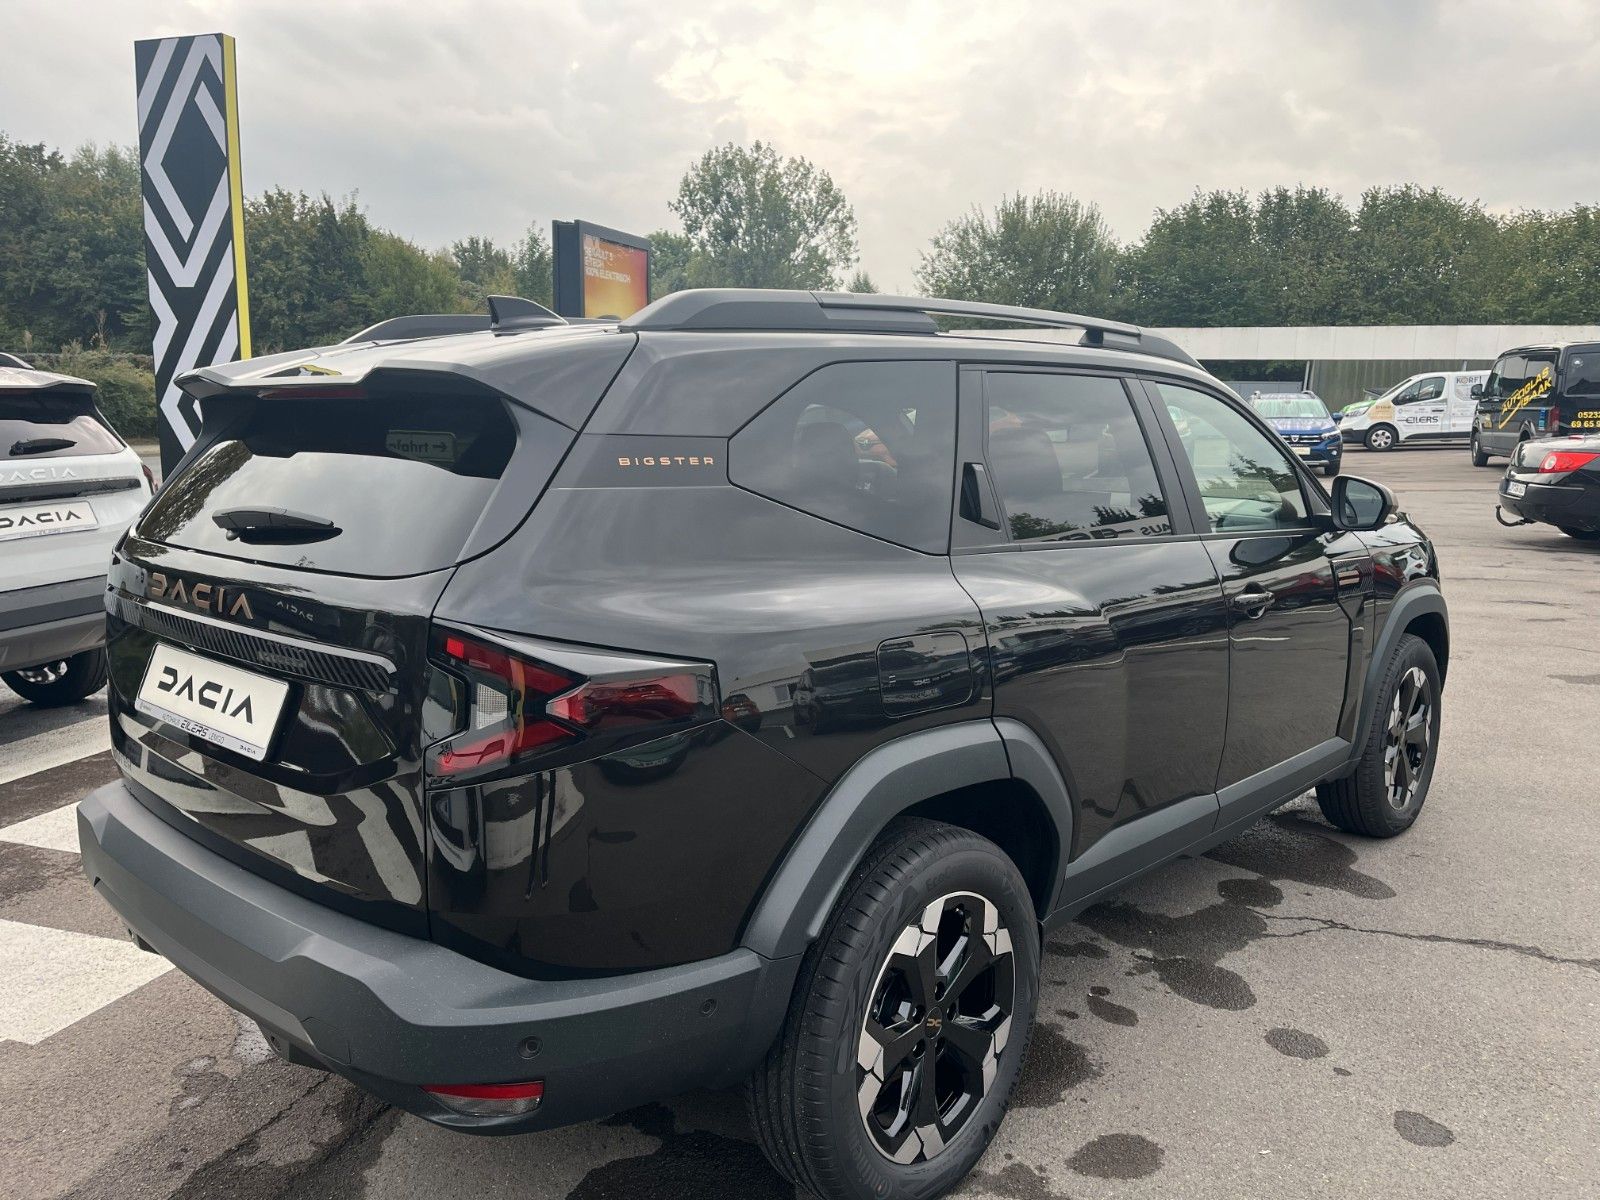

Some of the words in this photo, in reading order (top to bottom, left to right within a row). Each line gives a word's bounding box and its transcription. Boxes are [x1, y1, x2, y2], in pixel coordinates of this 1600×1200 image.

[1501, 366, 1550, 415] AUTOGLAS
[1405, 415, 1439, 424] EILERS
[1571, 420, 1582, 428] 69
[1583, 420, 1595, 428] 65
[618, 457, 714, 466] BIGSTER
[0, 467, 76, 481] ACIA
[150, 572, 253, 620] DACIA
[157, 665, 253, 724] DACIA
[180, 719, 209, 737] EILERS
[240, 744, 256, 755] DACIA
